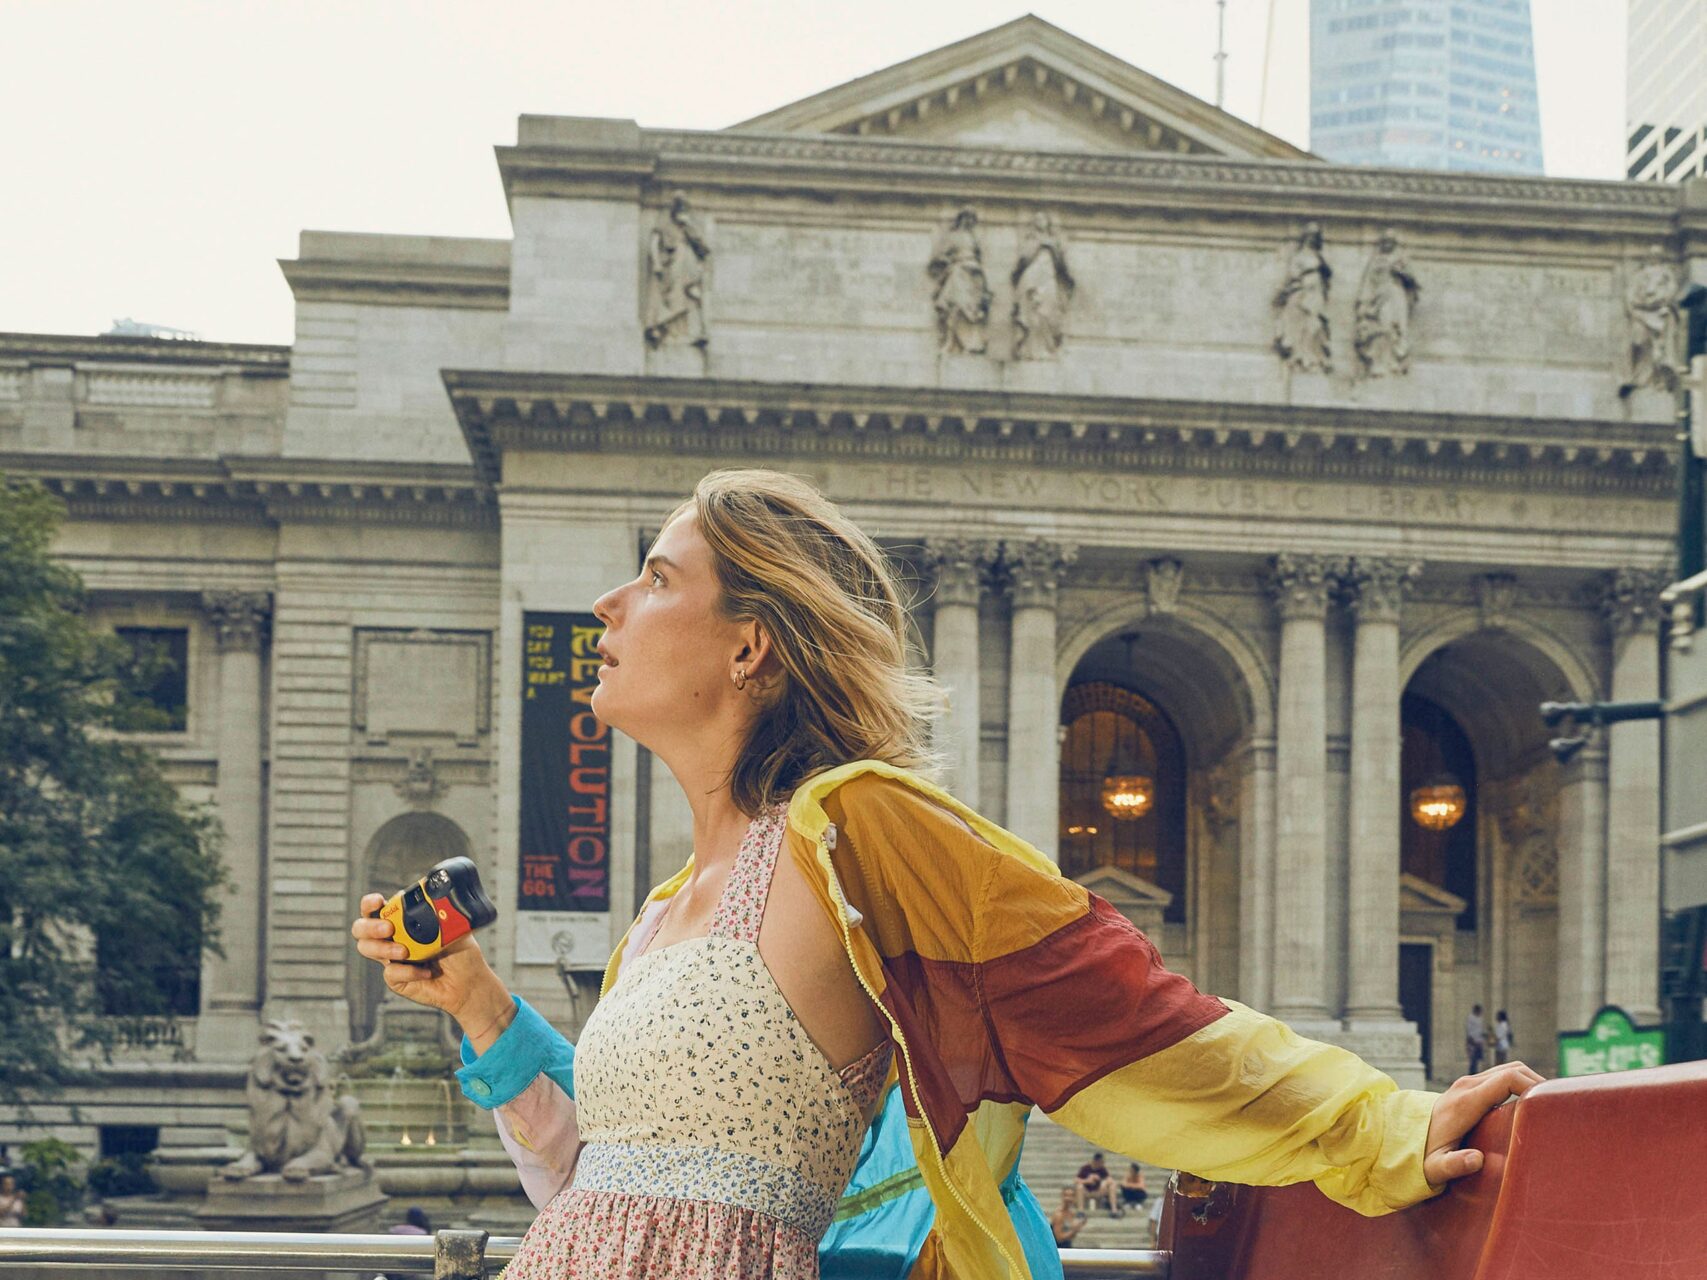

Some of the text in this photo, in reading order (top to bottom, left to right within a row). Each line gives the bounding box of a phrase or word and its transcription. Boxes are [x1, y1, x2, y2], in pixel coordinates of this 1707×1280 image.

[859, 466, 933, 496] THE
[960, 470, 1047, 498] NEW
[1073, 475, 1168, 505] YORK
[1197, 480, 1314, 511] PUBLIC
[1345, 486, 1479, 519] LIBRARY
[528, 625, 554, 638] YOU
[527, 640, 550, 653] SAY
[528, 656, 553, 669] YOU
[528, 671, 566, 685] WANT
[527, 687, 537, 699] A
[568, 625, 608, 897] REVOLUTION
[524, 863, 554, 879] THE
[382, 903, 400, 920] Kodak
